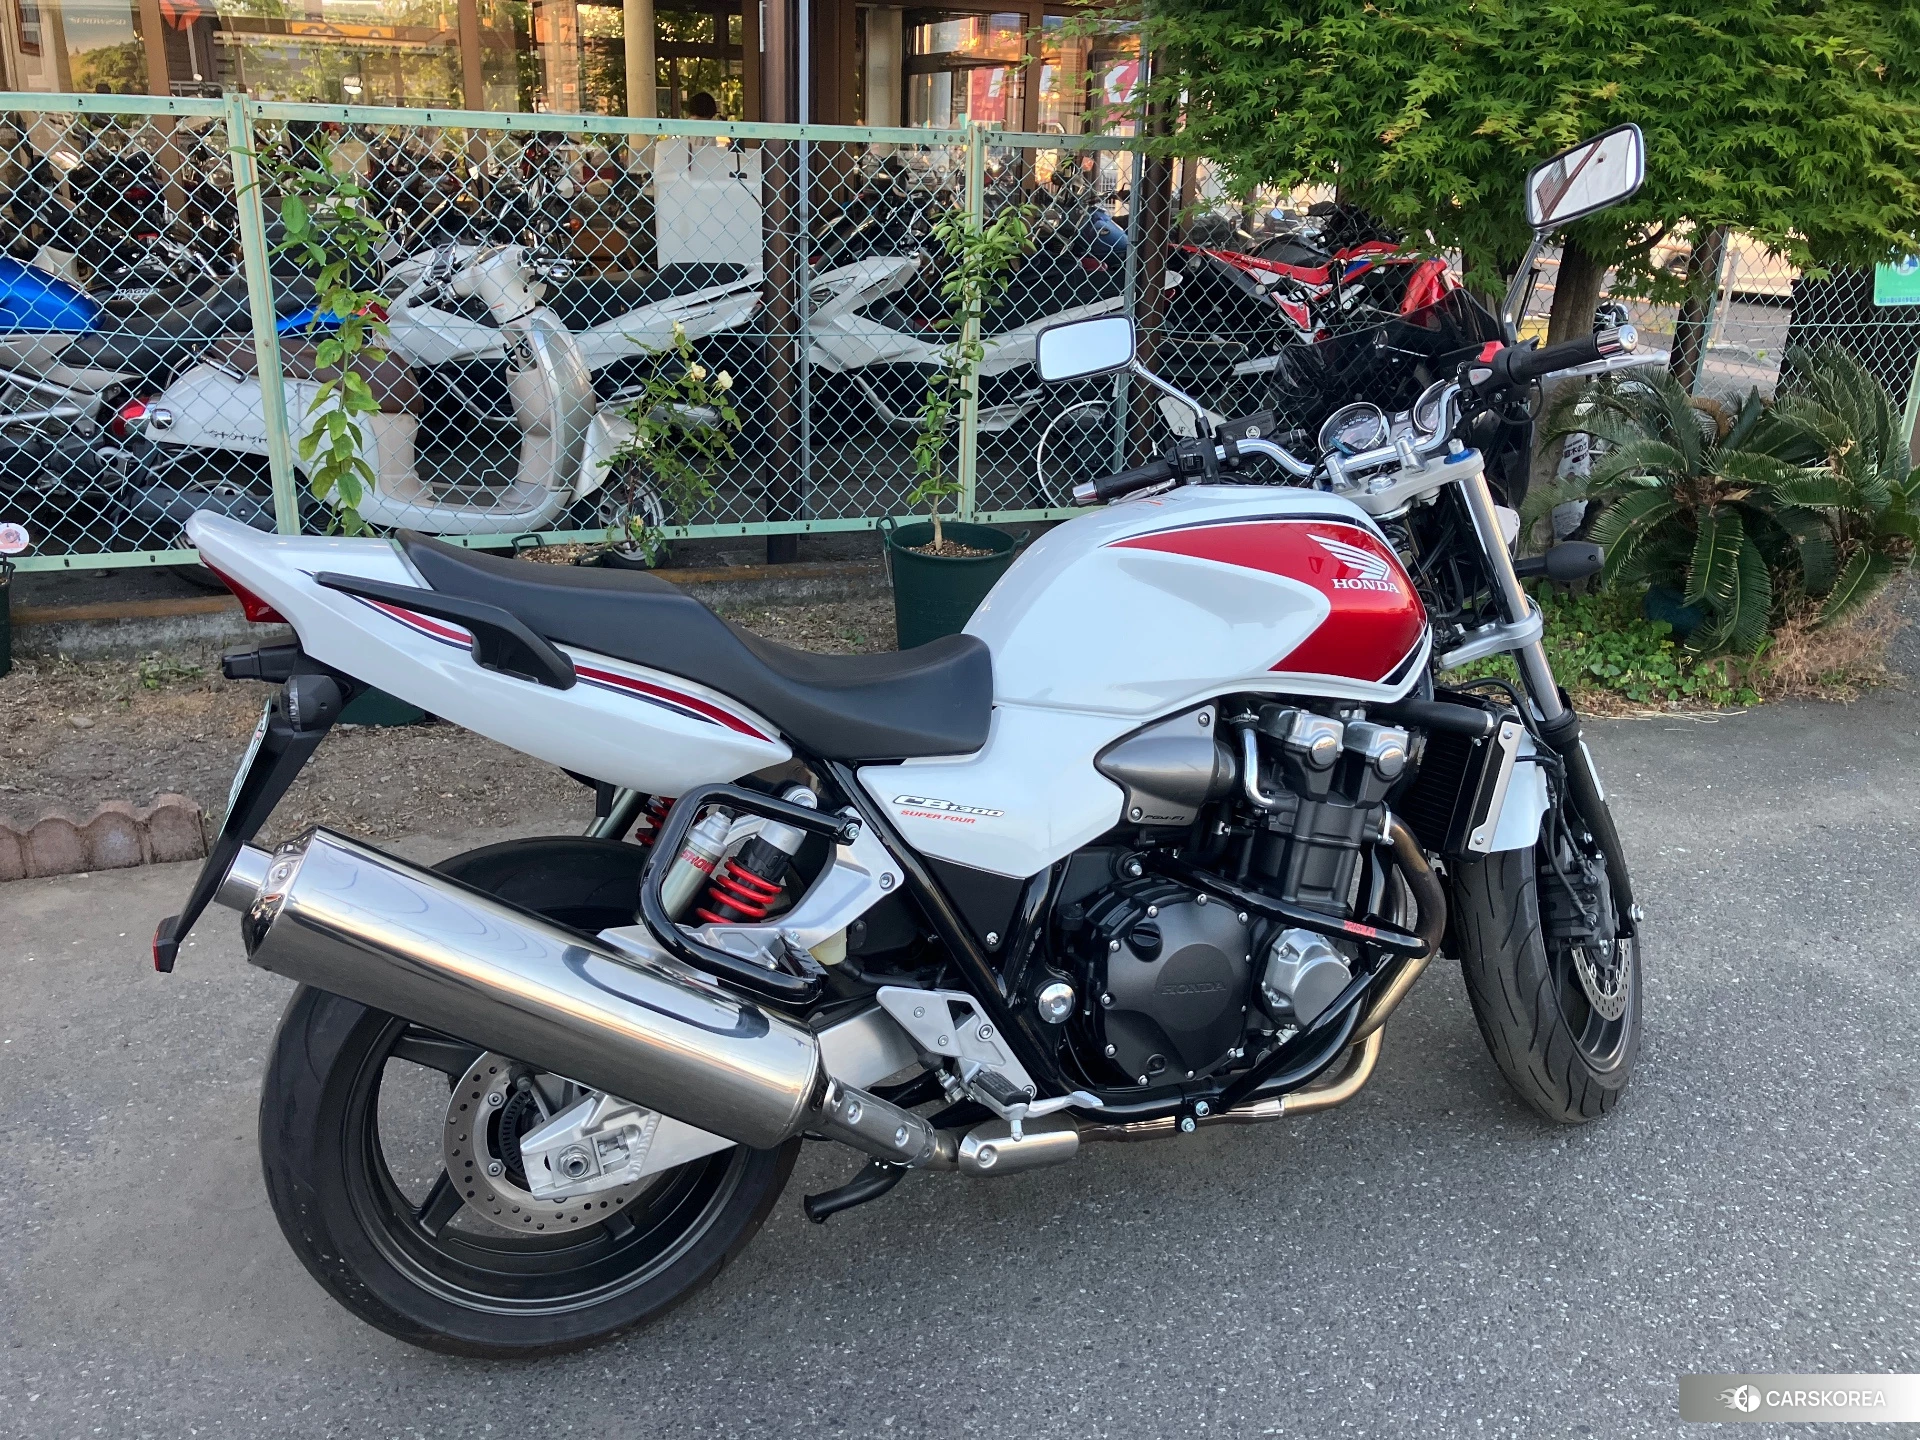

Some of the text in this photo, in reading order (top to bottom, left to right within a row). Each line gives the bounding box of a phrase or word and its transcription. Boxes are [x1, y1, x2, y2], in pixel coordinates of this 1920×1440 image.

[1241, 255, 1271, 266] HONDA
[1331, 578, 1400, 594] HONDA
[893, 795, 1005, 817] CB1300
[901, 809, 976, 824] SUPER FOUR
[1161, 982, 1226, 995] HONDA
